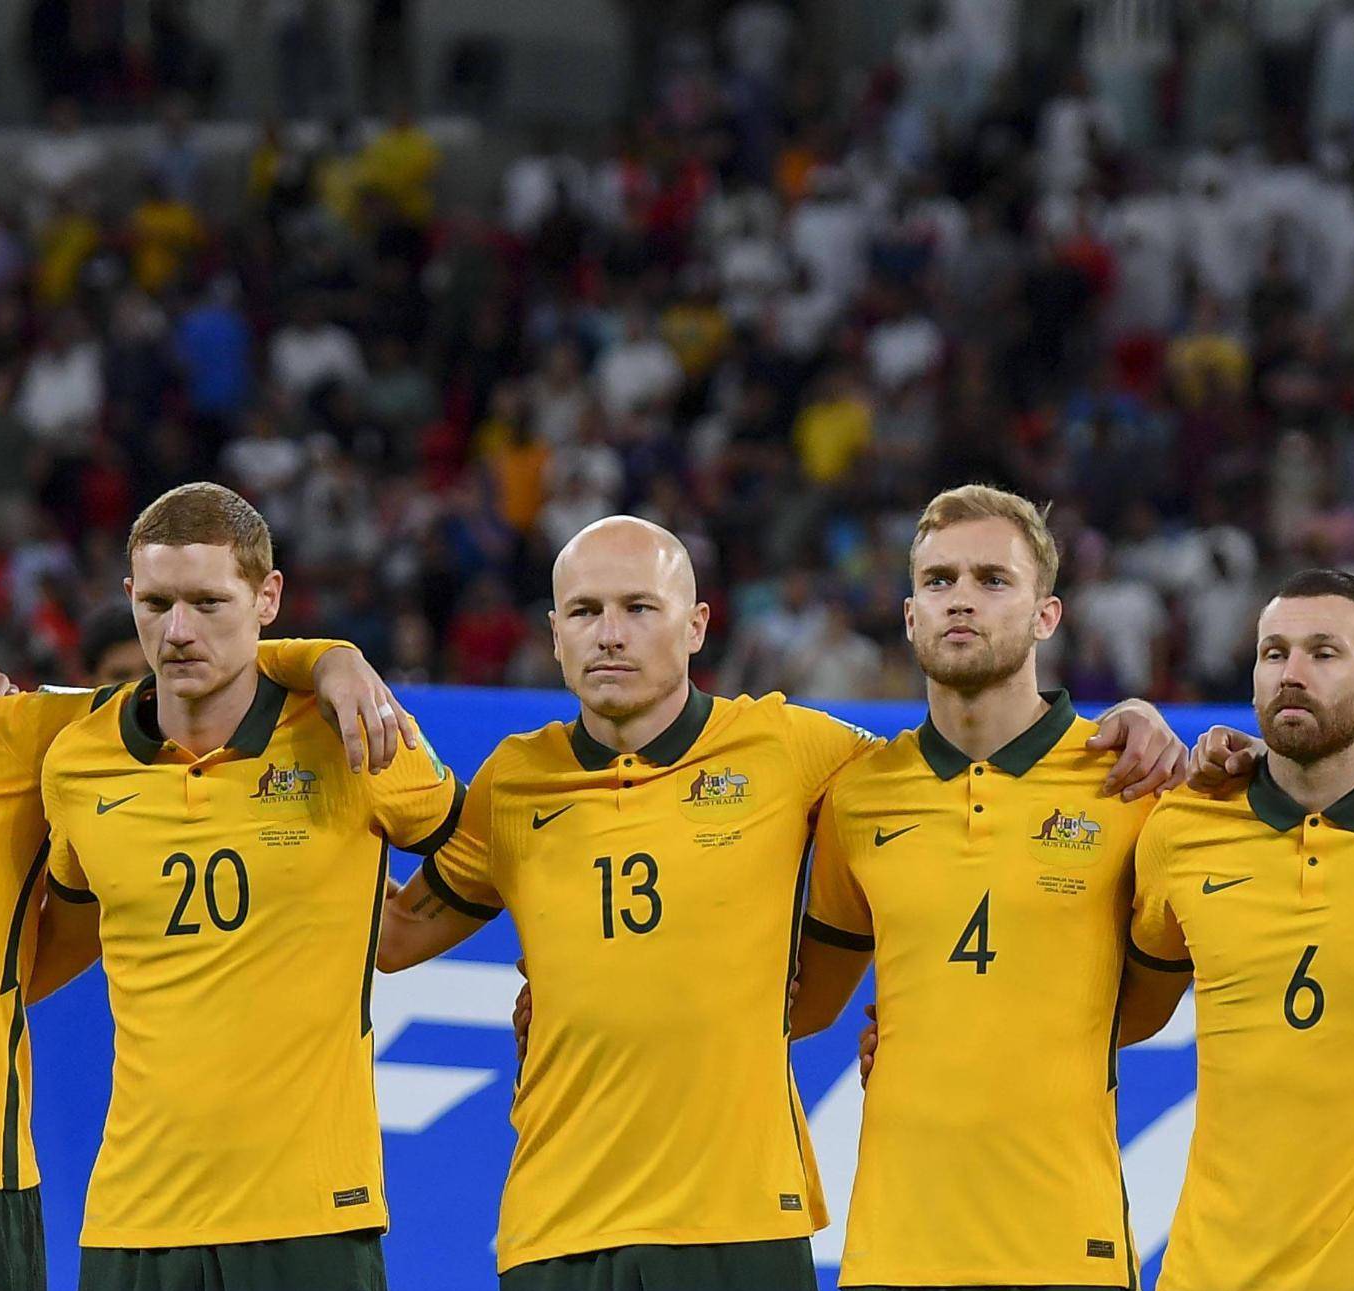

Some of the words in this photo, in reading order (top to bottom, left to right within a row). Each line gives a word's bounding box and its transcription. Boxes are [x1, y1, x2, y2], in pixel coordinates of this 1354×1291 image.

[260, 795, 310, 804] AUSTRALIA
[693, 797, 744, 808] AUSTRALIA
[1041, 841, 1091, 851] AUSTRALIA
[161, 848, 250, 937] 20
[593, 852, 662, 939] 13
[948, 889, 997, 975] 4
[1283, 945, 1325, 1030] 6
